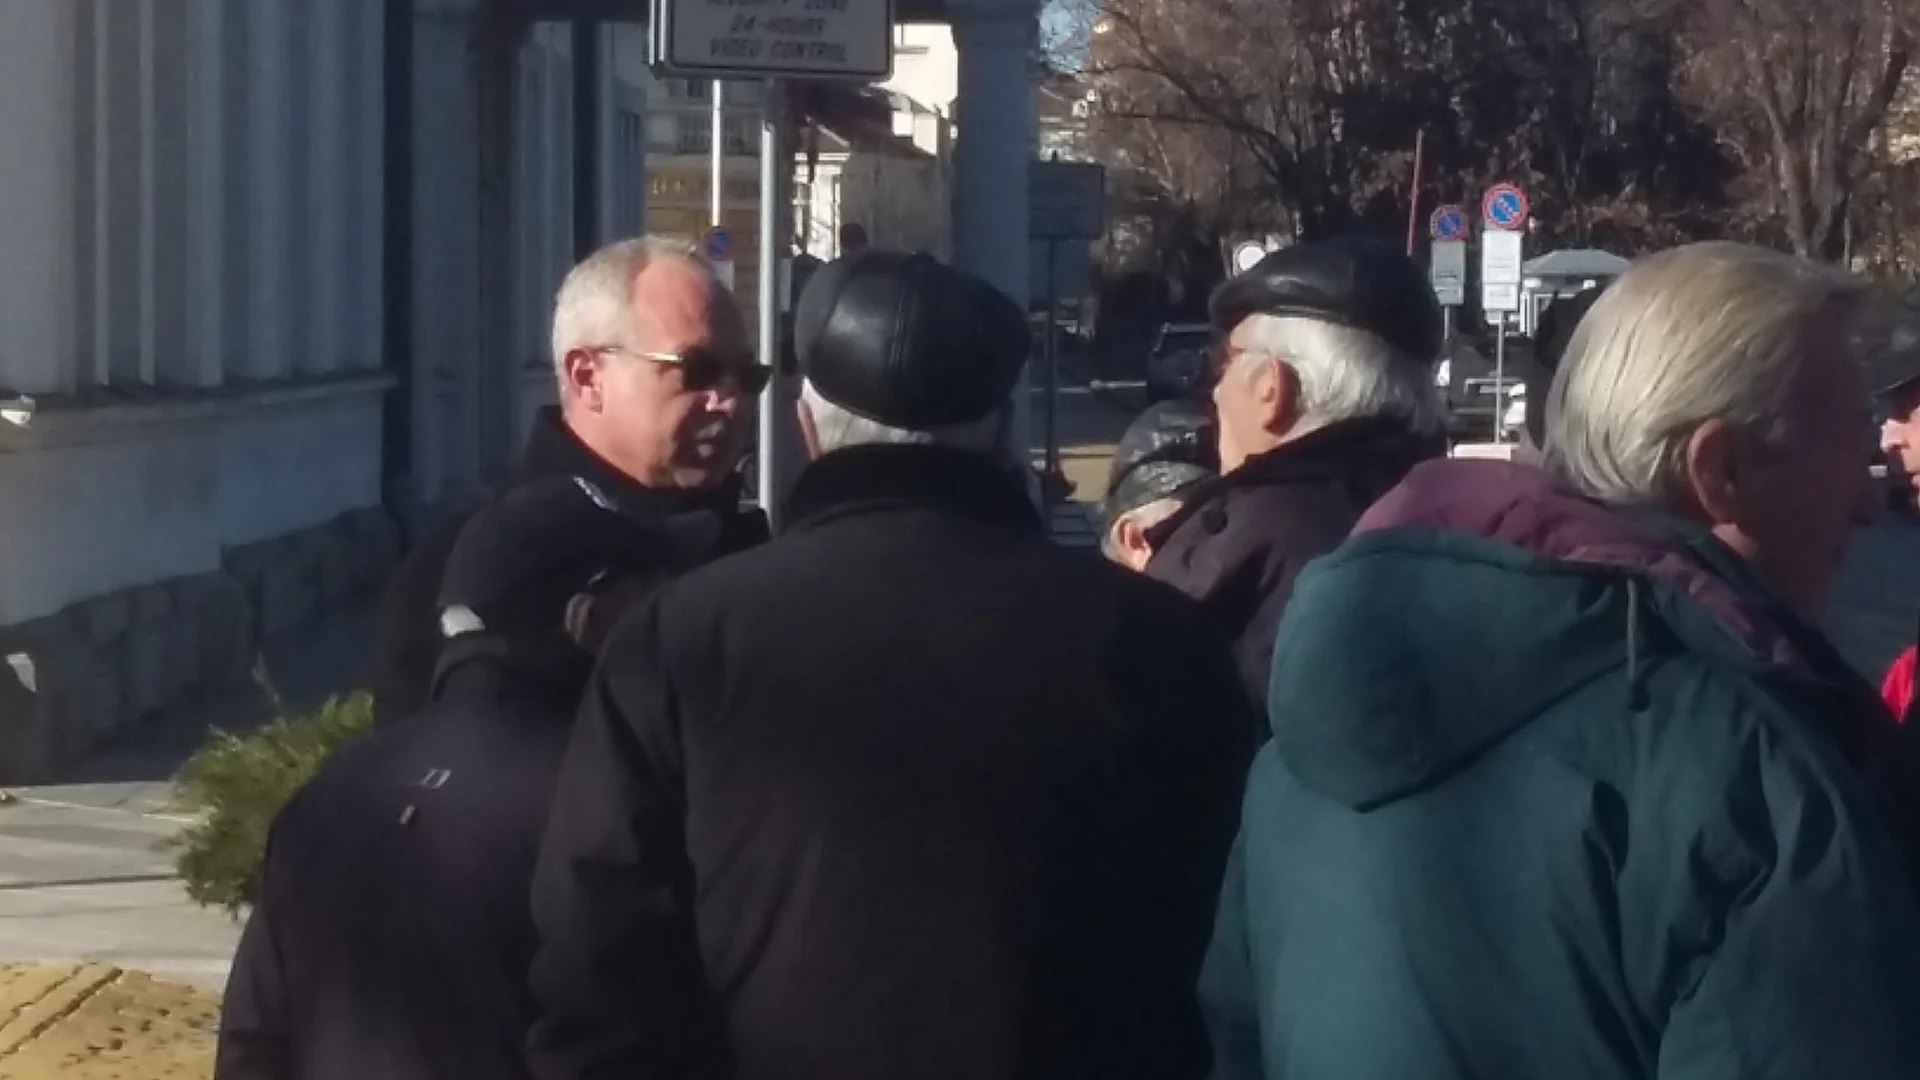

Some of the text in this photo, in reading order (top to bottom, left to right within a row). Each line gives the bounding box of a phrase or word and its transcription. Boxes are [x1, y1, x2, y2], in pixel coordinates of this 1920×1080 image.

[731, 14, 826, 36] 24-HOURS
[711, 38, 846, 62] VIDEO CONTROL
